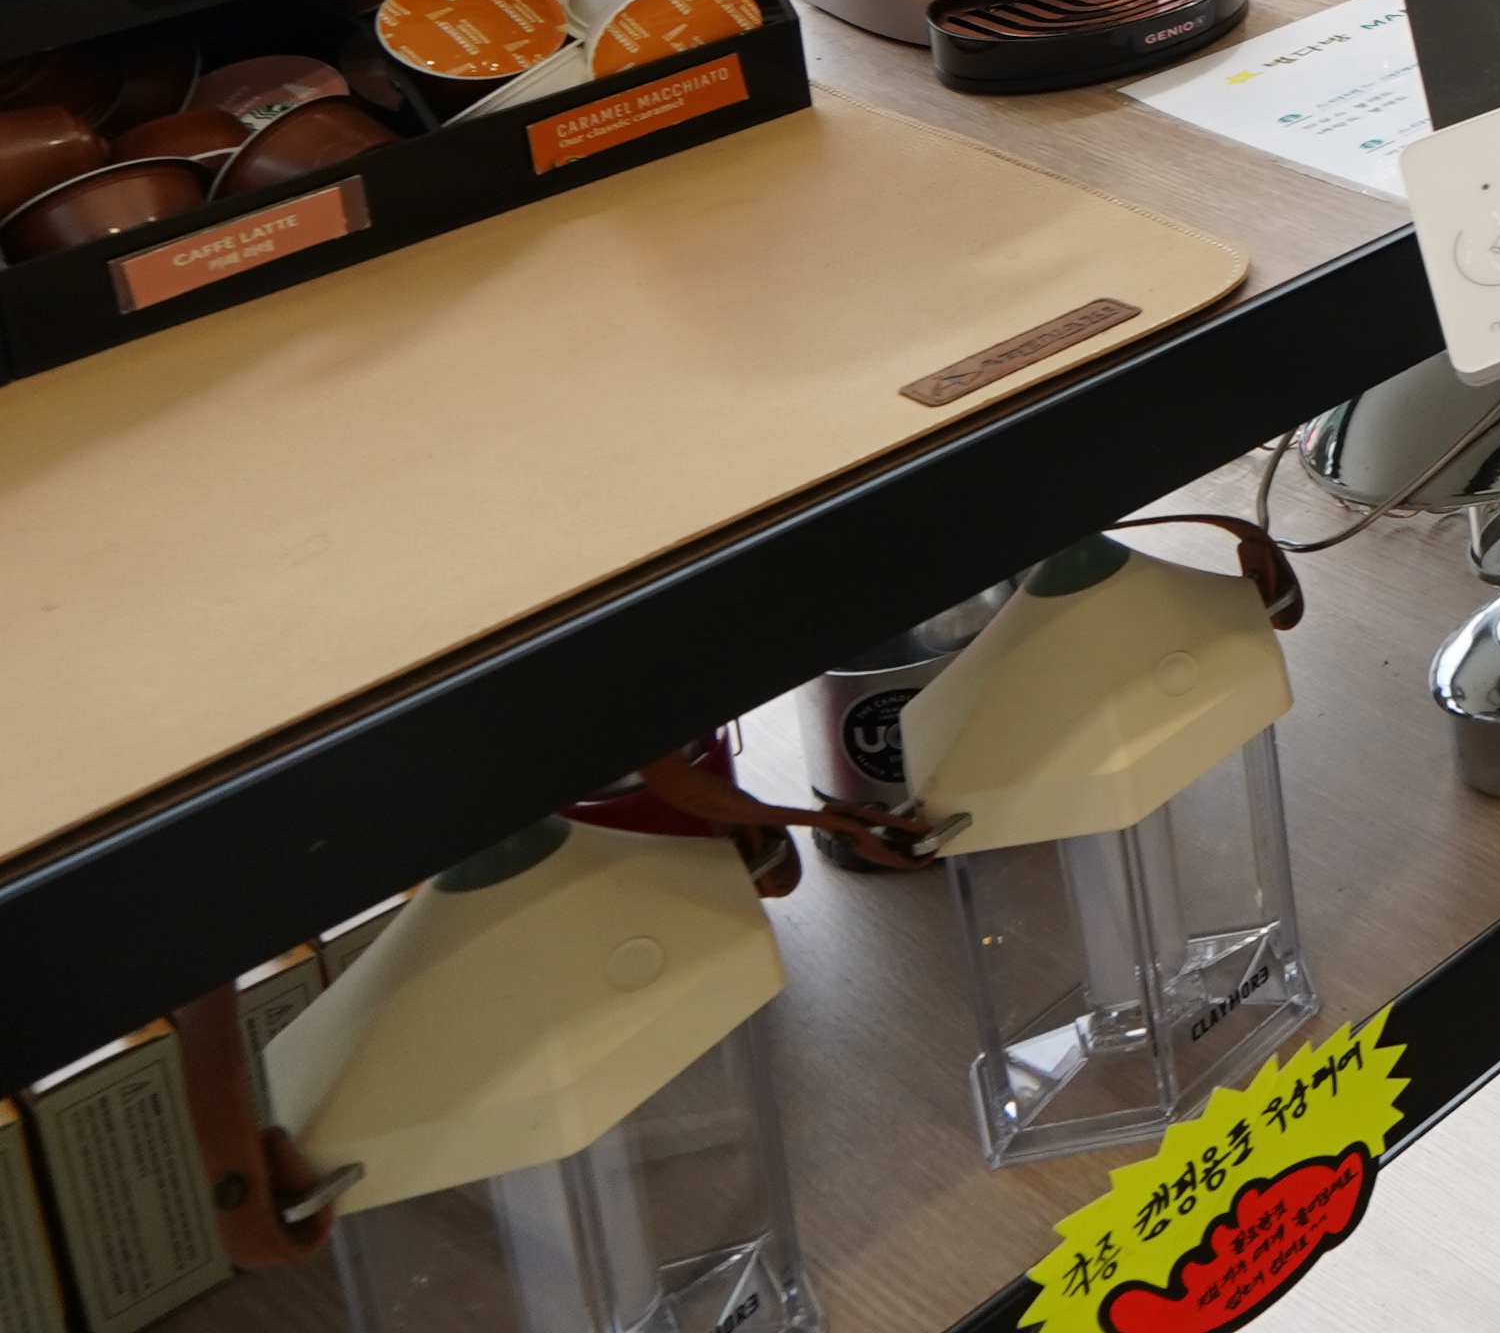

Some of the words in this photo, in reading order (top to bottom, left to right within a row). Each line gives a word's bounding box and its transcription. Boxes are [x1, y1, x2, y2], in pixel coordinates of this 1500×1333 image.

[1144, 20, 1195, 46] GENIO
[556, 101, 634, 138] CARAMEL
[637, 66, 730, 109] MACCHIATO
[633, 98, 685, 125] caramel
[1132, 1117, 1256, 1242] 캠핑용품
